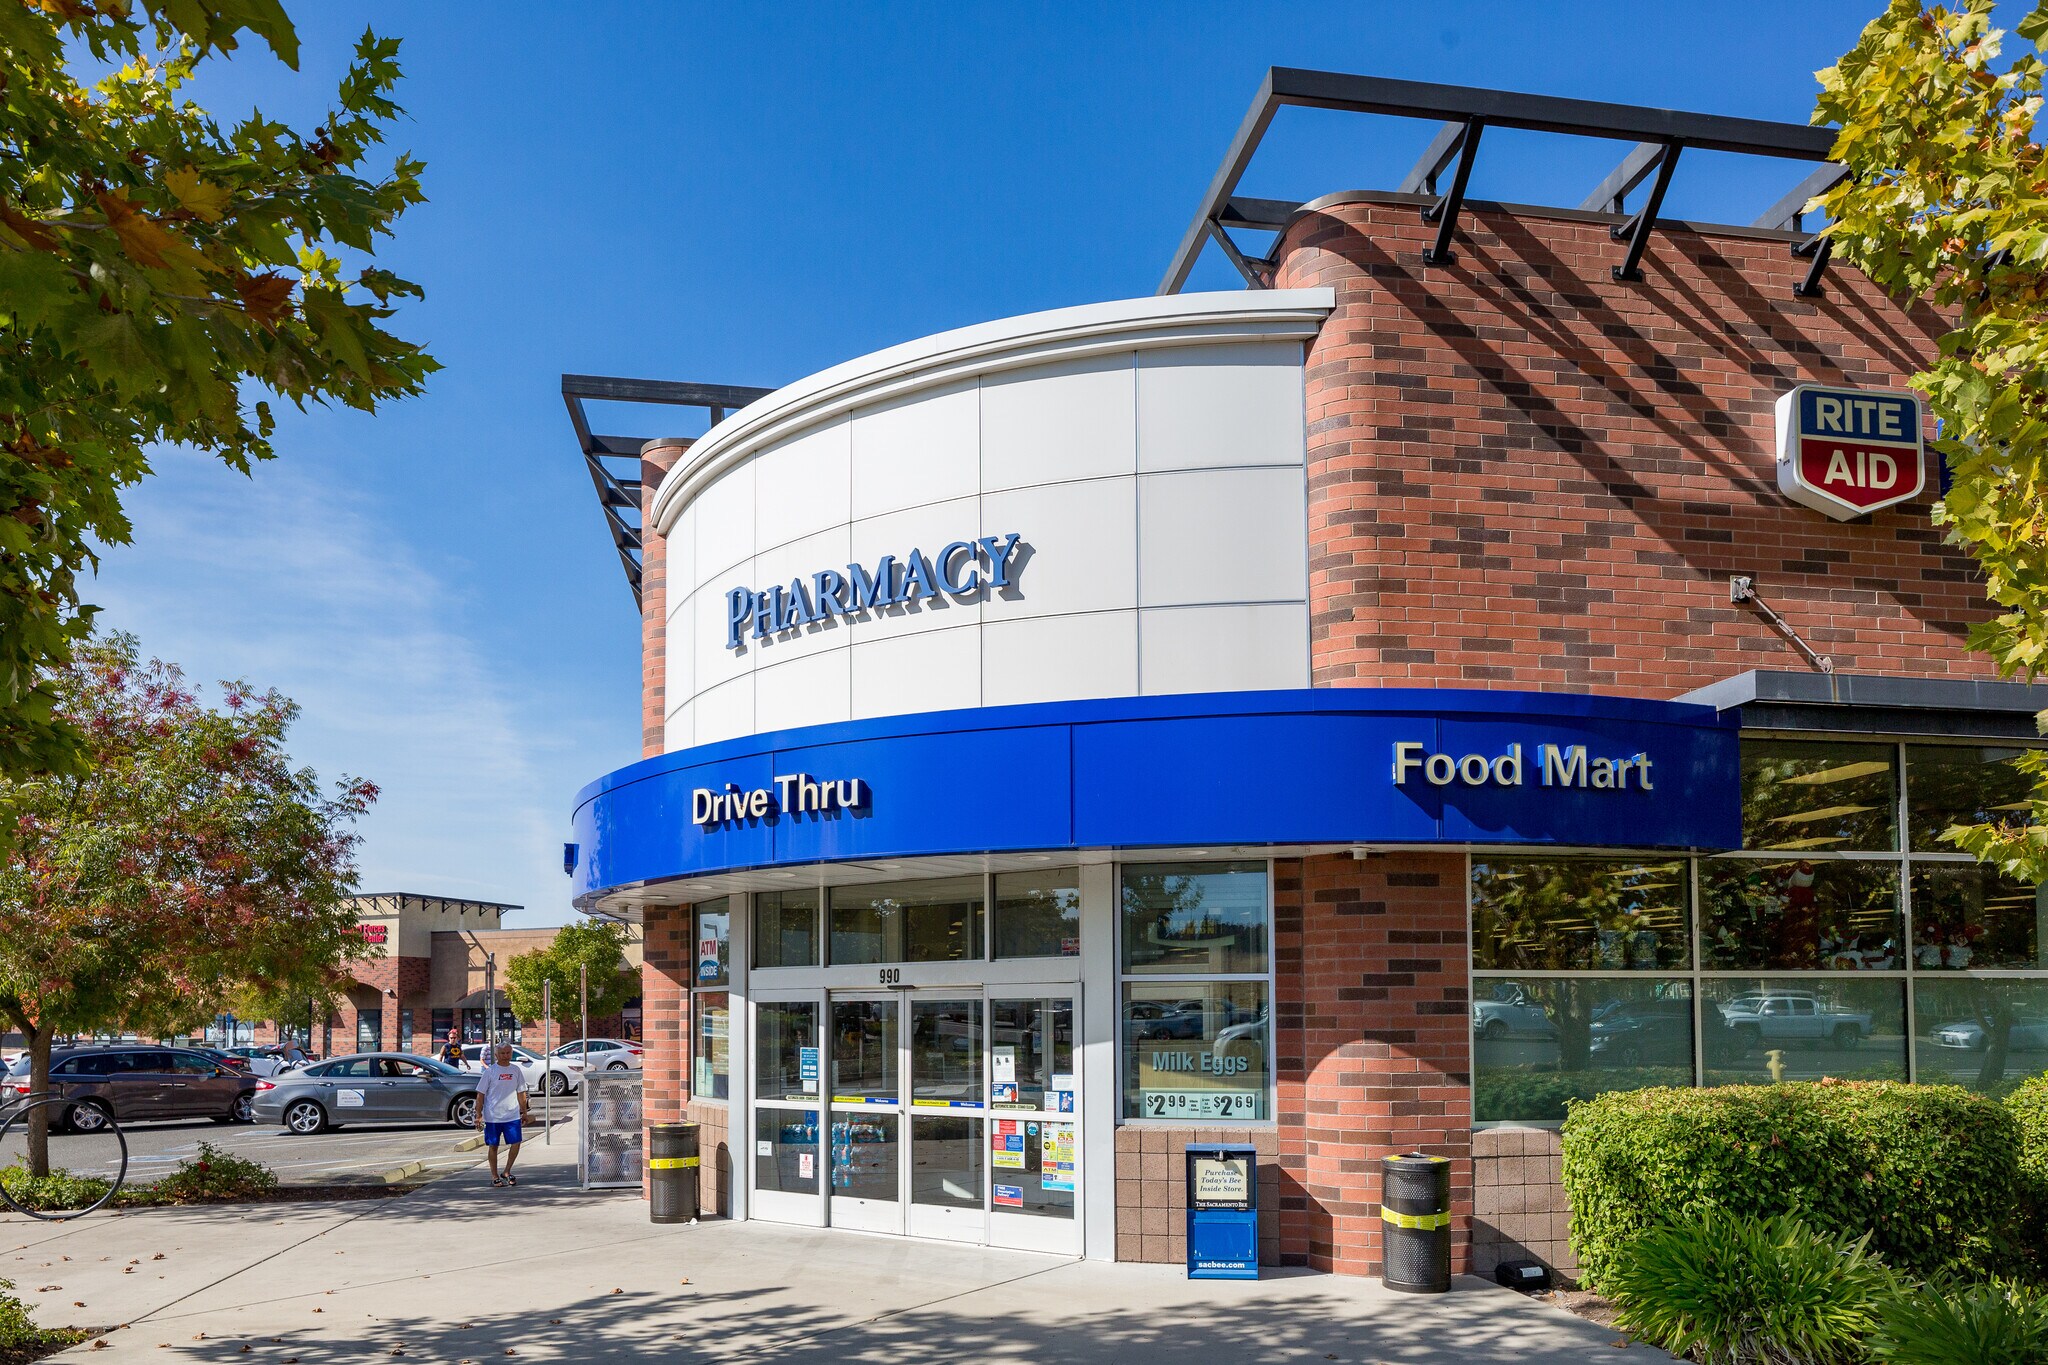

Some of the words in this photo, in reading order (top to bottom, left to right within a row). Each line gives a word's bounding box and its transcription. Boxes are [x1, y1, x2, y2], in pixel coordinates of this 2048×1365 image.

[1815, 396, 1903, 437] RITE
[1823, 449, 1898, 490] AID
[725, 533, 1022, 651] PHARMACY
[1392, 741, 1523, 787] Food
[1538, 742, 1654, 790] Mart
[692, 783, 770, 826] Drive
[774, 772, 860, 814] Thru
[700, 939, 717, 956] ATM
[879, 968, 900, 984] 990
[1152, 1051, 1195, 1072] Milk
[1200, 1051, 1248, 1076] Eggs
[1201, 1177, 1227, 1185] Today's
[1198, 1260, 1245, 1268] sacbee.com
